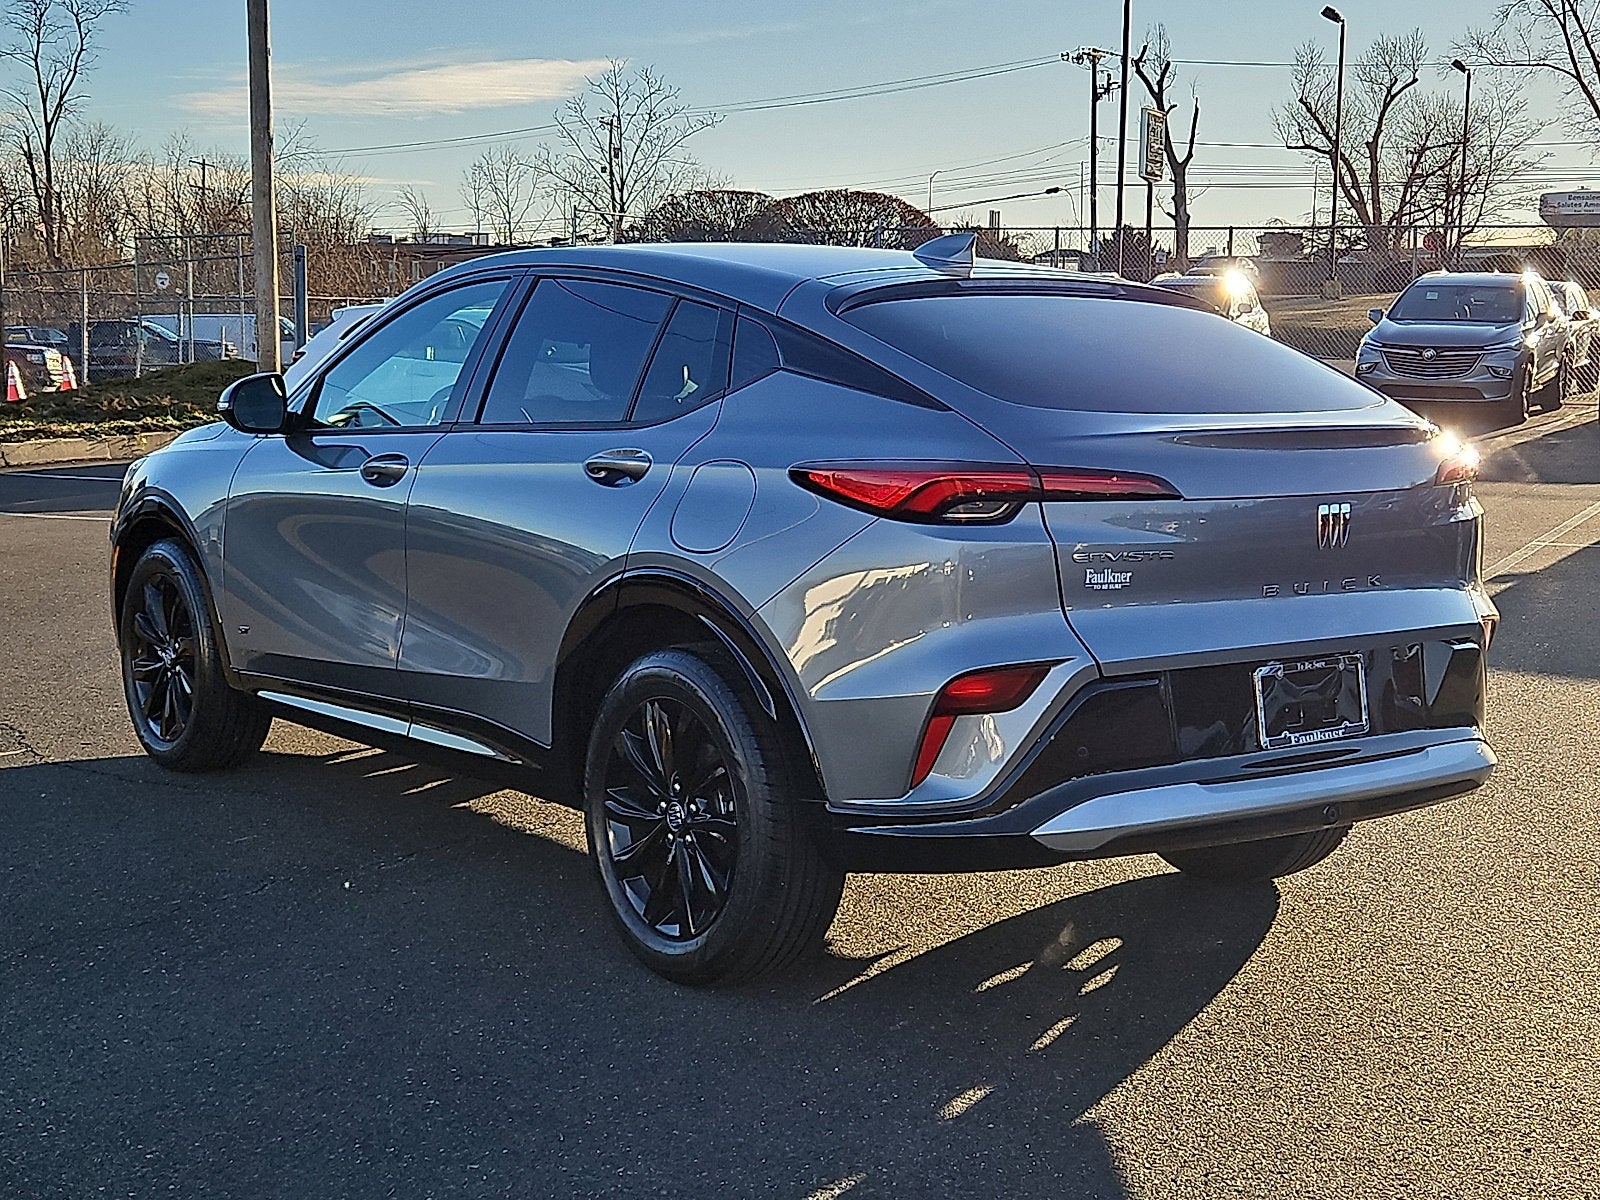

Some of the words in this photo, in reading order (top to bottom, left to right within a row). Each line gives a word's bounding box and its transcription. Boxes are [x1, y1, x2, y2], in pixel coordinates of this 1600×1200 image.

[1072, 549, 1176, 563] ENVISTA
[1085, 568, 1132, 584] Faulkner
[1261, 574, 1381, 597] BUICK
[1291, 728, 1346, 745] Faulkner
